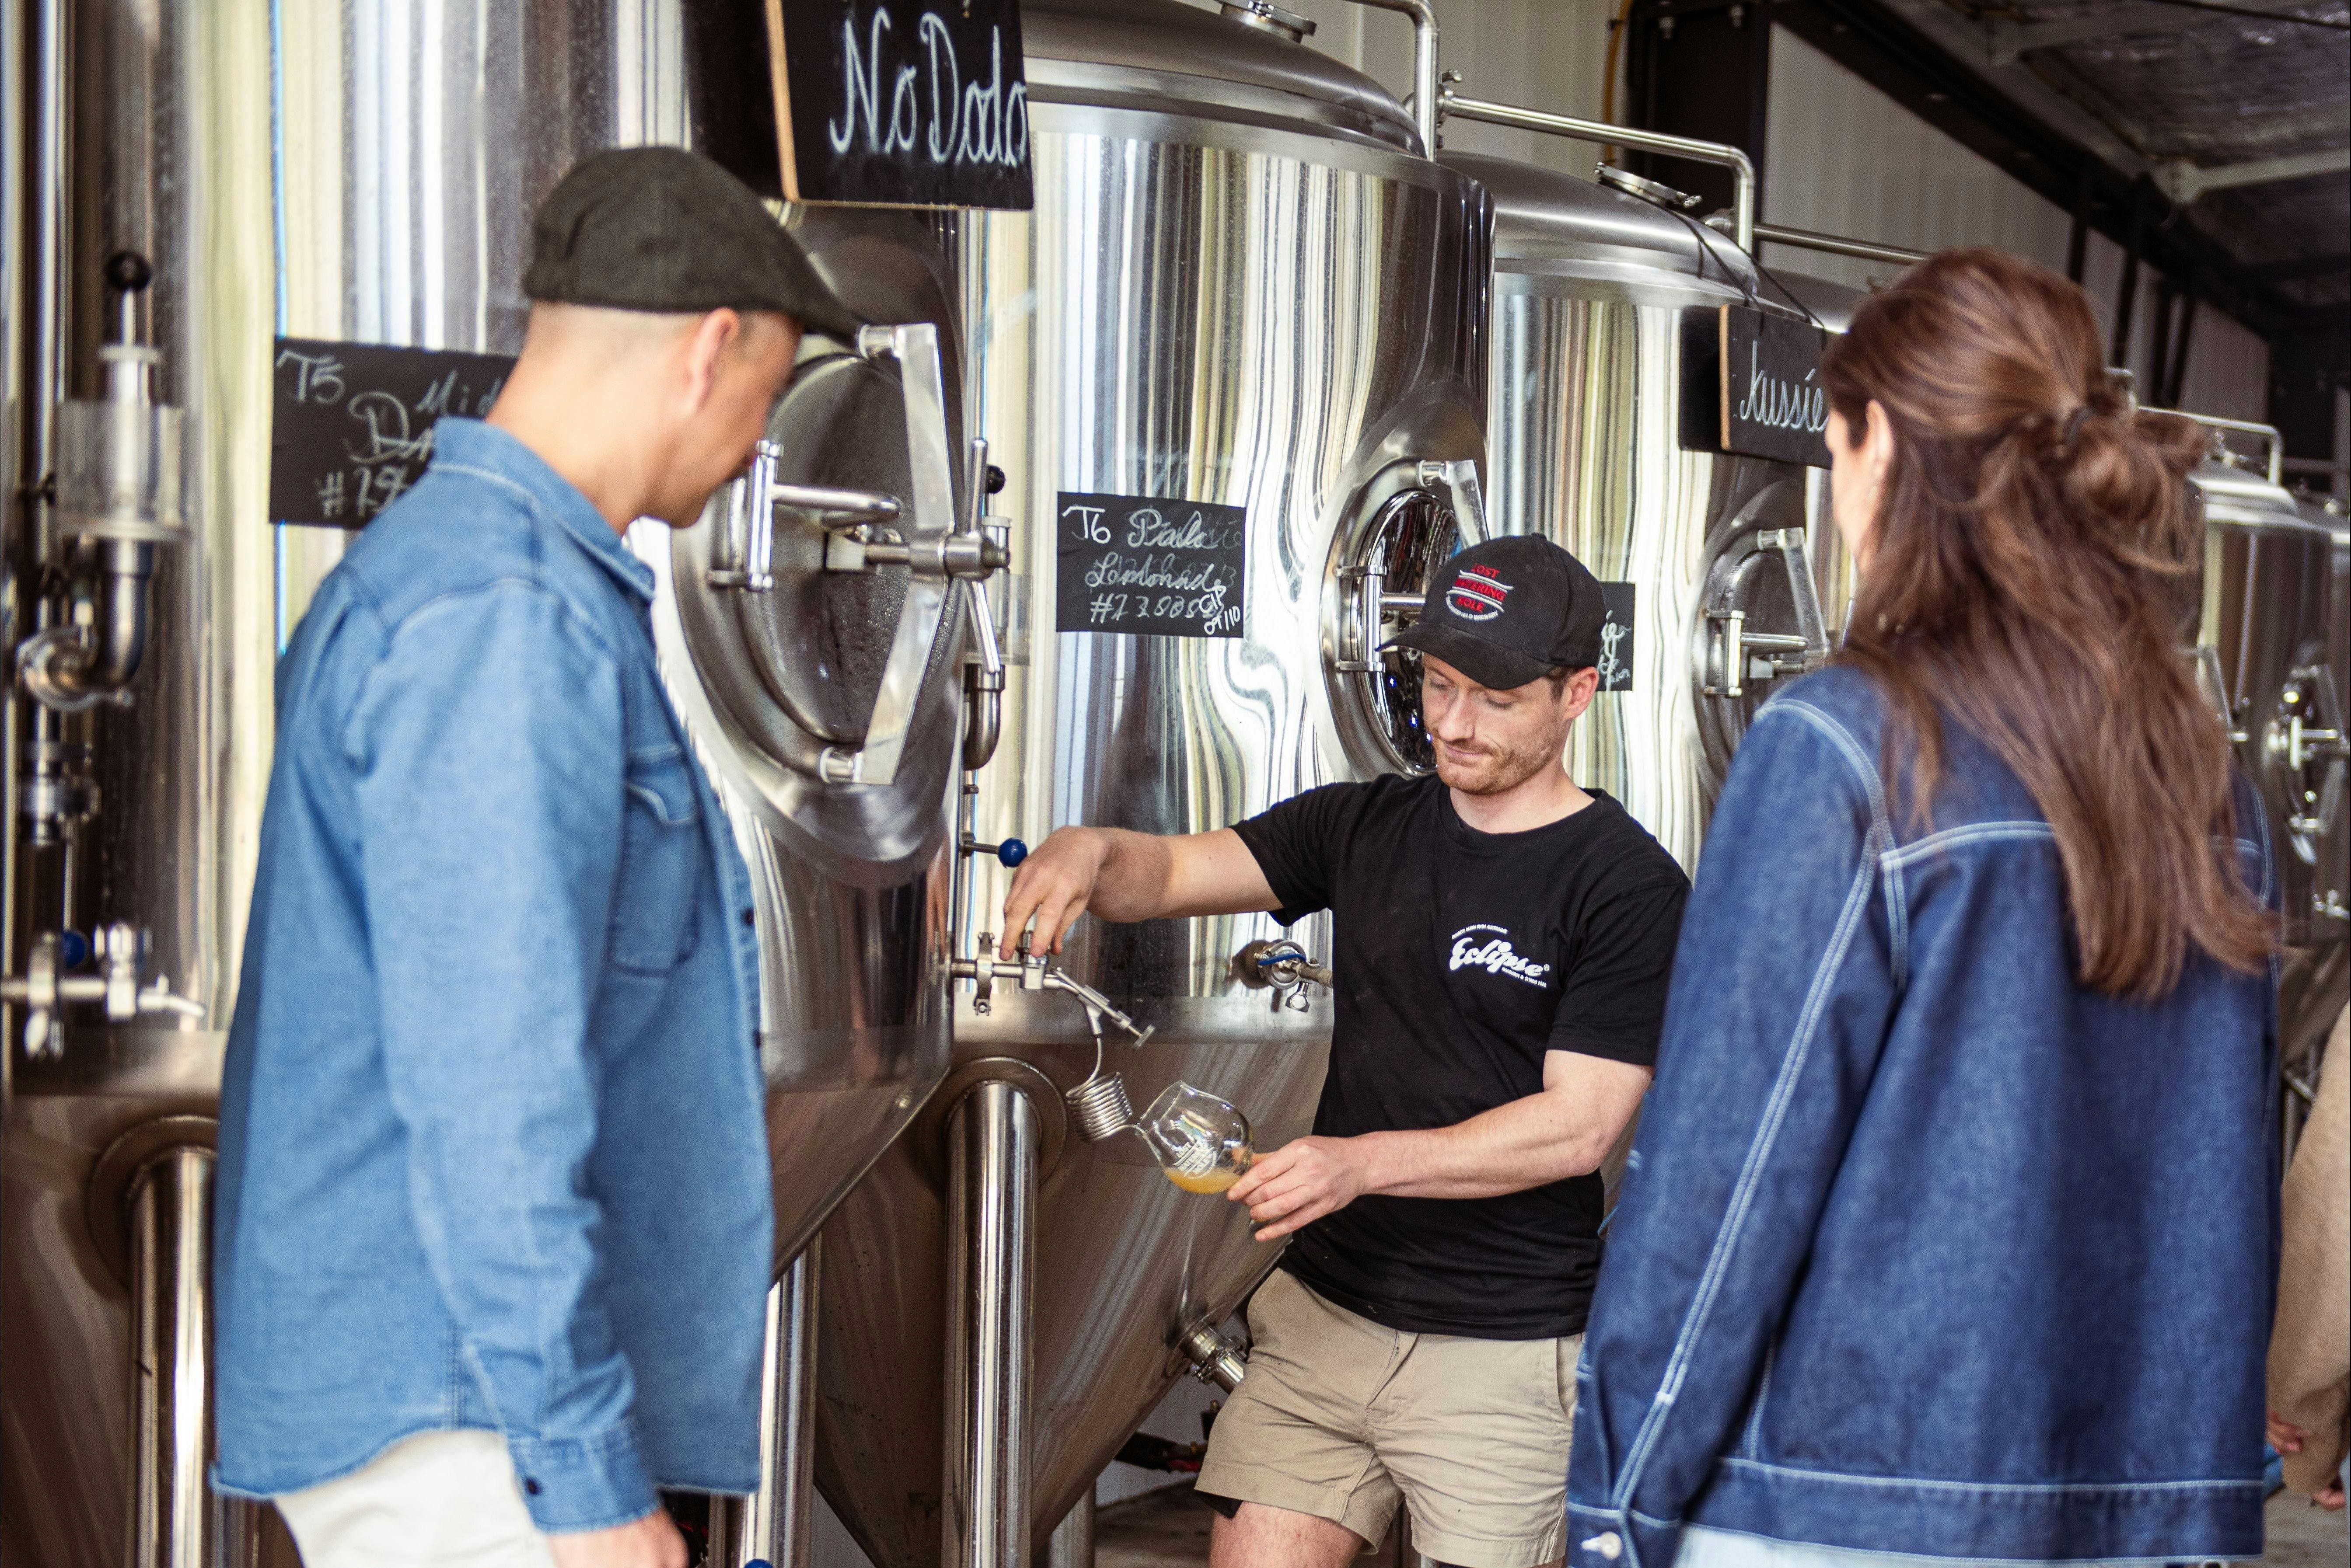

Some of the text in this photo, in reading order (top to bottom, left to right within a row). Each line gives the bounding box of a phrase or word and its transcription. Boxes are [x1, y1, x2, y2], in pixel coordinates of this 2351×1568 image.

[276, 349, 346, 404] T5
[1062, 505, 1111, 544] T6
[1449, 937, 1543, 976] Eclipse
